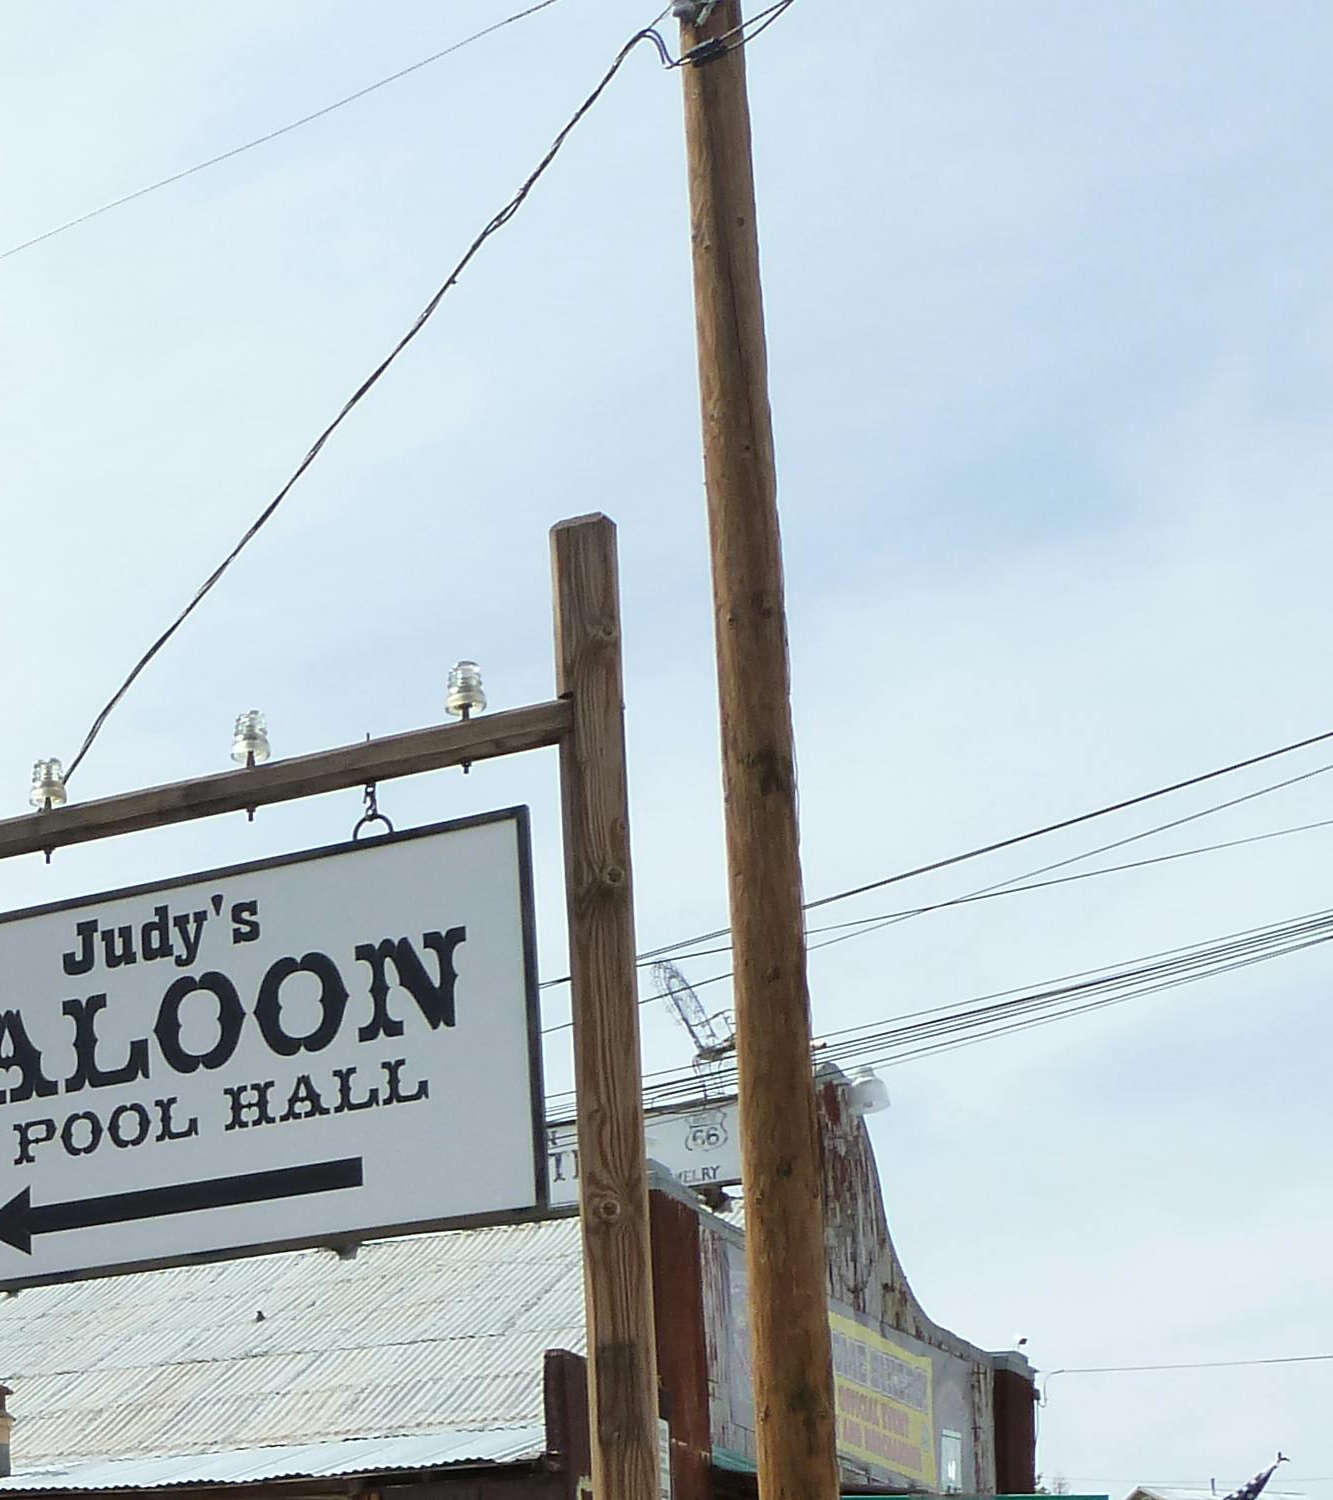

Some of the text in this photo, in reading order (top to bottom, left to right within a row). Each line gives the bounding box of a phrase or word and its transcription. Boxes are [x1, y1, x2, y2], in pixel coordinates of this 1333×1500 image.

[62, 893, 261, 976] Judy's
[13, 1095, 200, 1166] POOL
[224, 1058, 429, 1131] HALL
[691, 1126, 721, 1146] 66
